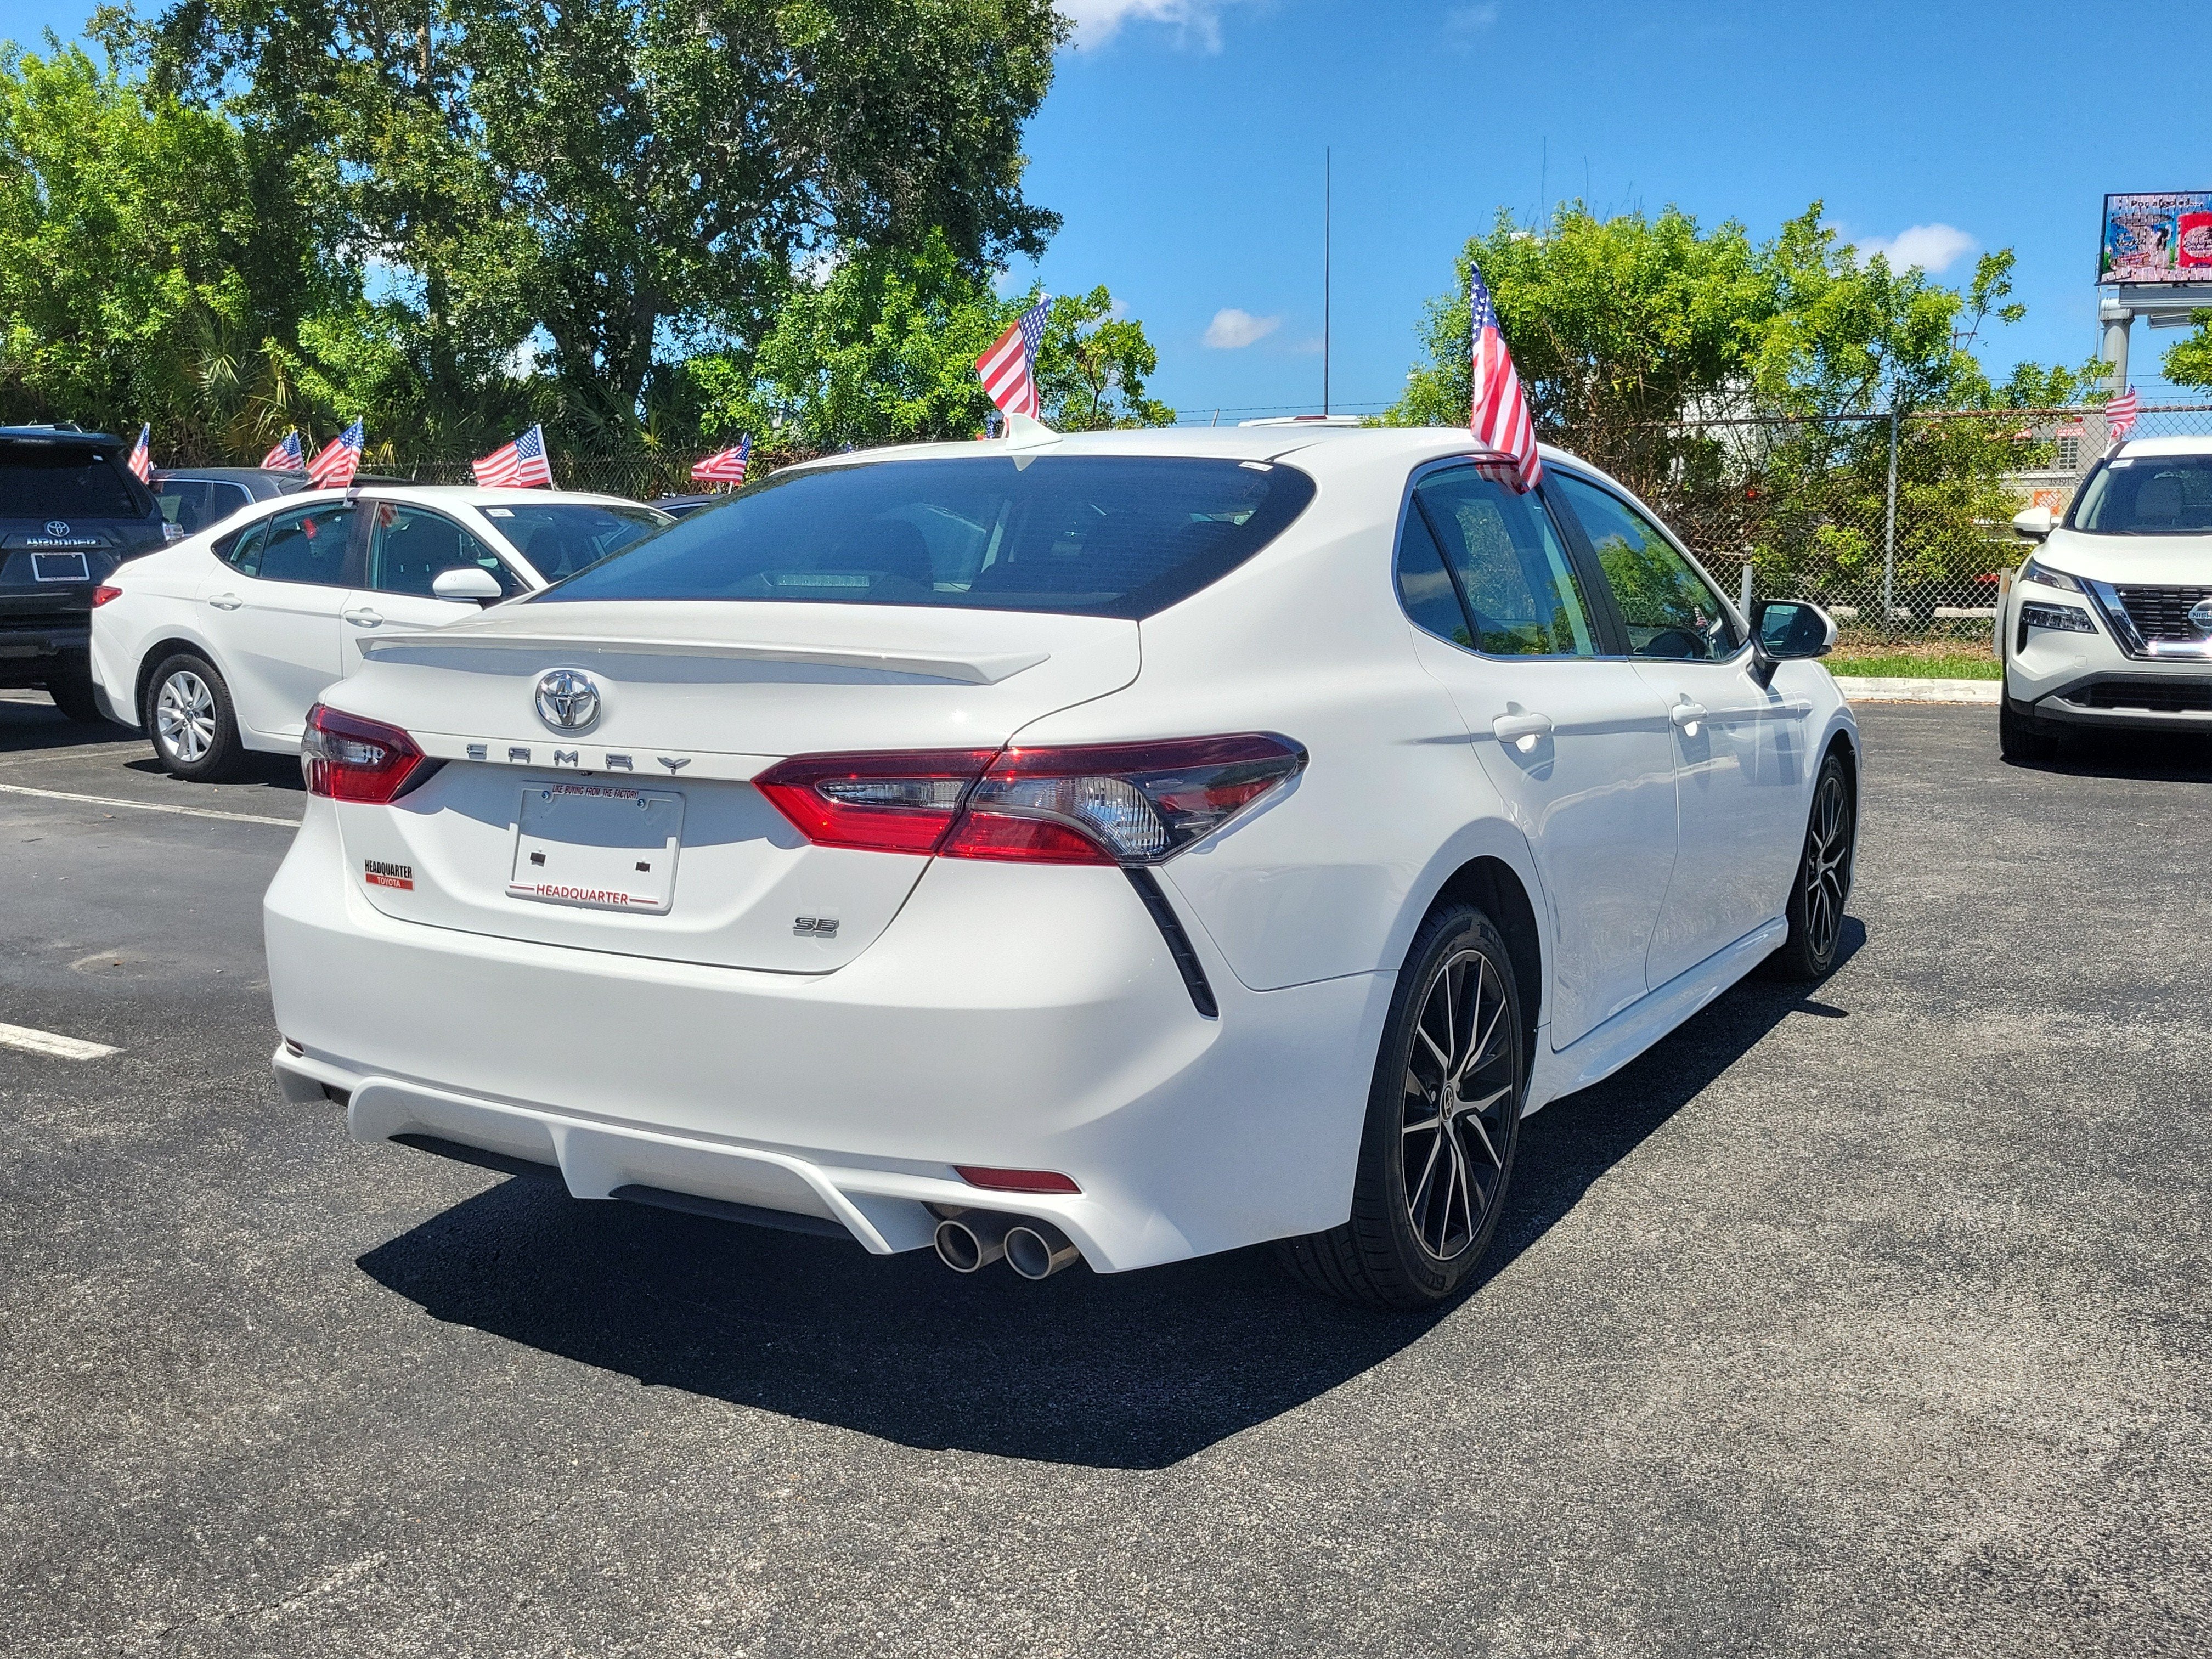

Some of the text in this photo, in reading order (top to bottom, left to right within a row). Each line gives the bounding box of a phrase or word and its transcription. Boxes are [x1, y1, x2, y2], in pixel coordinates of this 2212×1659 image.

[466, 743, 692, 775] CAMRY
[552, 785, 563, 793] LIKE
[565, 786, 584, 795] BUYING
[585, 787, 601, 796] FROM
[602, 788, 612, 797] THE
[365, 859, 413, 879] HEADQUARTER
[377, 876, 401, 888] TOYOTA
[536, 884, 628, 905] HEADQUARTER
[792, 916, 839, 933] SE
